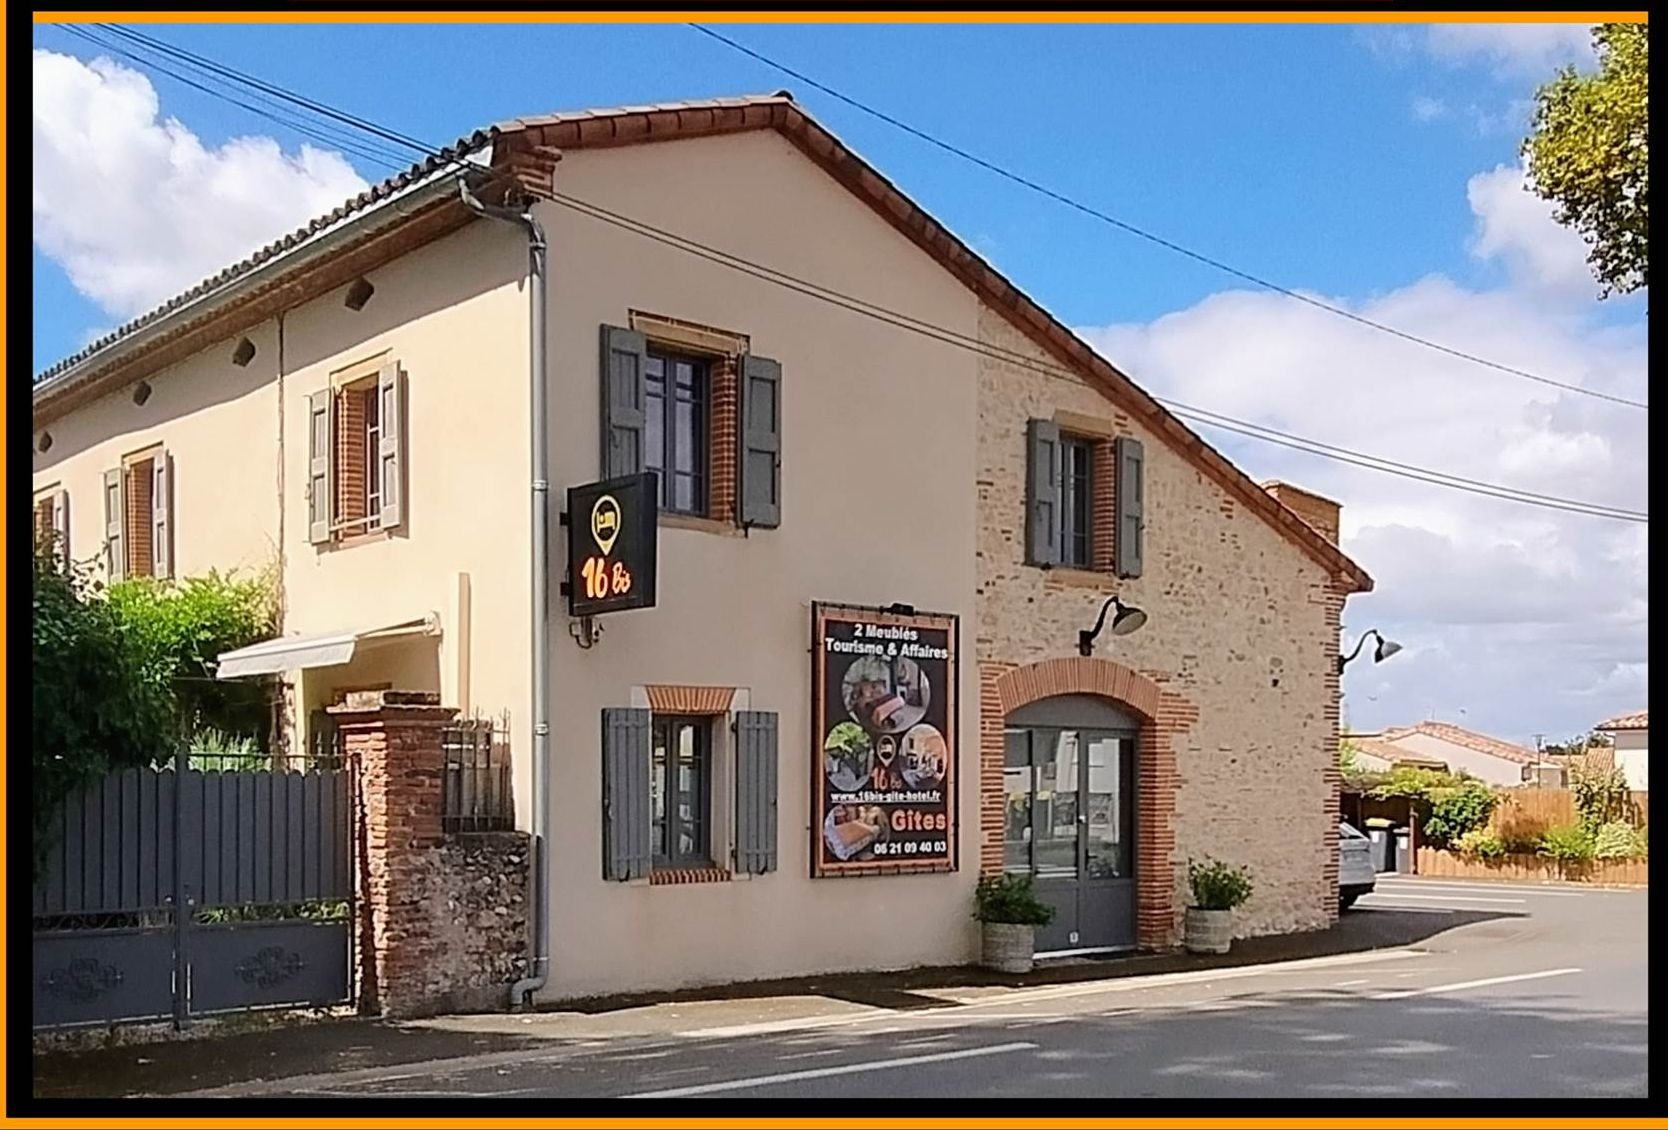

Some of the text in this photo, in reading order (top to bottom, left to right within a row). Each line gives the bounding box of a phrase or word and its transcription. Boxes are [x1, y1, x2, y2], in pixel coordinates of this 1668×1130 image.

[581, 557, 608, 598] 16
[854, 623, 918, 641] 2 Meublés
[825, 637, 948, 659] Tourisme & Affaires
[889, 842, 902, 855] 21
[919, 841, 932, 853] 40
[933, 841, 947, 853] 03
